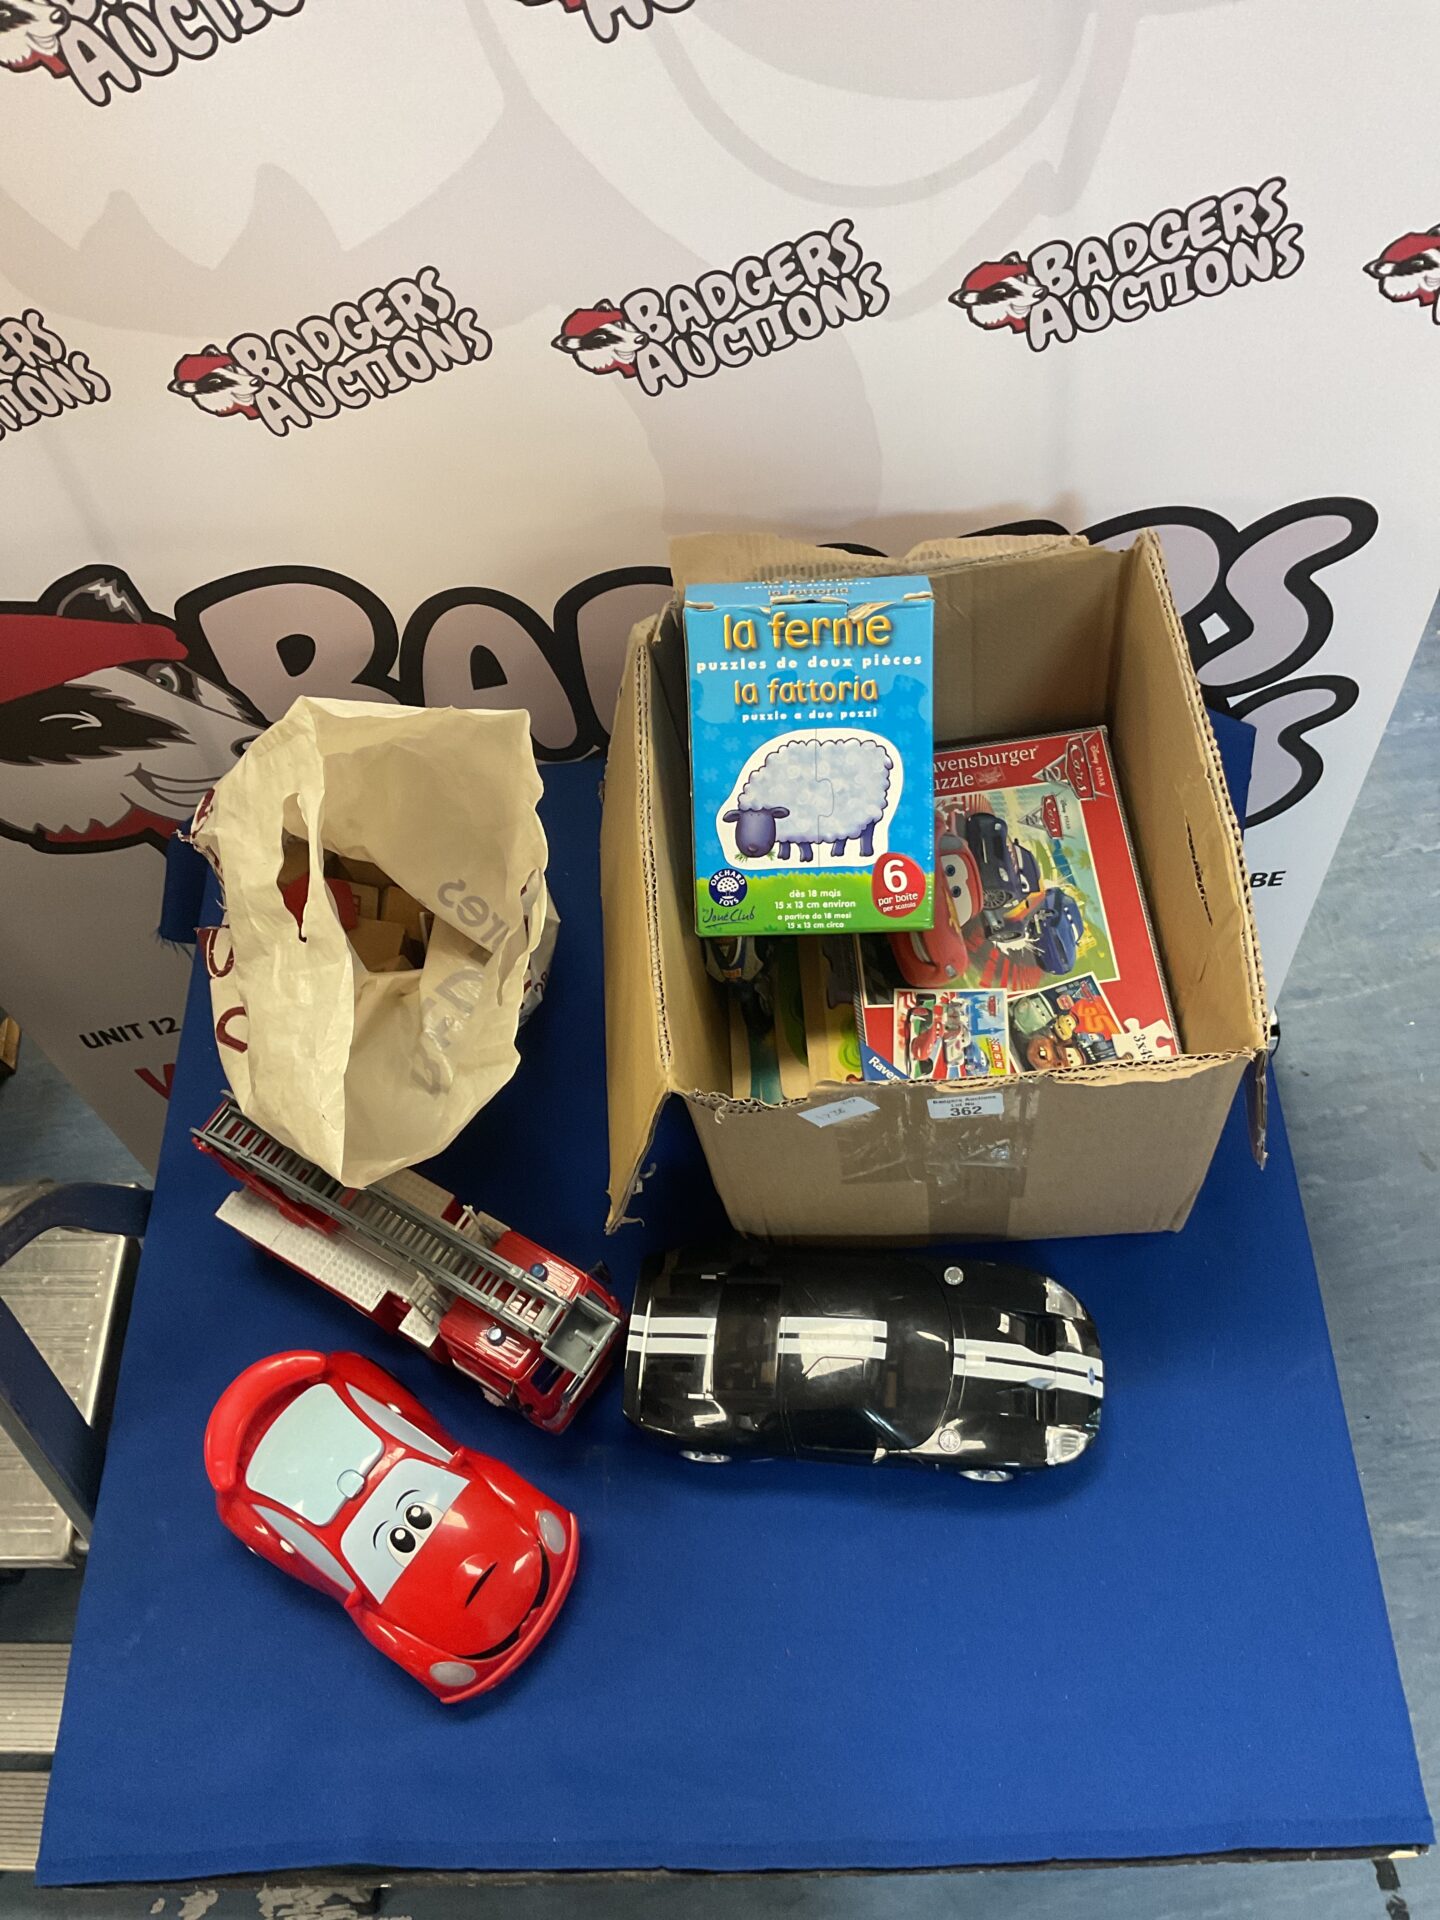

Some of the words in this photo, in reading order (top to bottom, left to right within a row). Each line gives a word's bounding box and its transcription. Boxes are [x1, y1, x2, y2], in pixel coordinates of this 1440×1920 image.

[58, 0, 306, 107] AUCTI
[1027, 176, 1288, 298] BADGERS
[619, 218, 863, 345] BADGERS
[1026, 222, 1305, 353] AUCTIONS
[226, 265, 456, 386] BADGERS
[636, 261, 890, 397] AUCTIONS
[254, 307, 493, 437] AUCTIONS
[723, 614, 758, 651] la
[768, 611, 893, 649] ferme
[696, 658, 767, 674] puzzles
[776, 657, 798, 670] de
[807, 655, 853, 668] deux
[862, 653, 923, 669] pièces
[734, 680, 759, 705] la
[767, 675, 879, 704] fattoria
[742, 710, 788, 723] puzzle
[794, 712, 802, 720] a
[808, 711, 834, 720] due
[840, 708, 878, 721] pezzi
[933, 745, 1038, 774] vensburger
[934, 771, 974, 790] zzle
[710, 869, 746, 887] ORCHARD
[883, 859, 908, 893] 6
[1249, 870, 1287, 888] BE
[719, 897, 739, 906] TOYS
[775, 901, 784, 909] 15
[822, 900, 857, 908] environ
[789, 890, 805, 898] dès
[808, 889, 817, 897] 18
[878, 896, 894, 907] par
[784, 913, 810, 921] partire
[883, 905, 894, 913] per
[79, 1023, 144, 1049] UNIT
[148, 1017, 181, 1036] 12
[868, 1055, 901, 1081] Raven
[950, 1106, 982, 1116] 362
